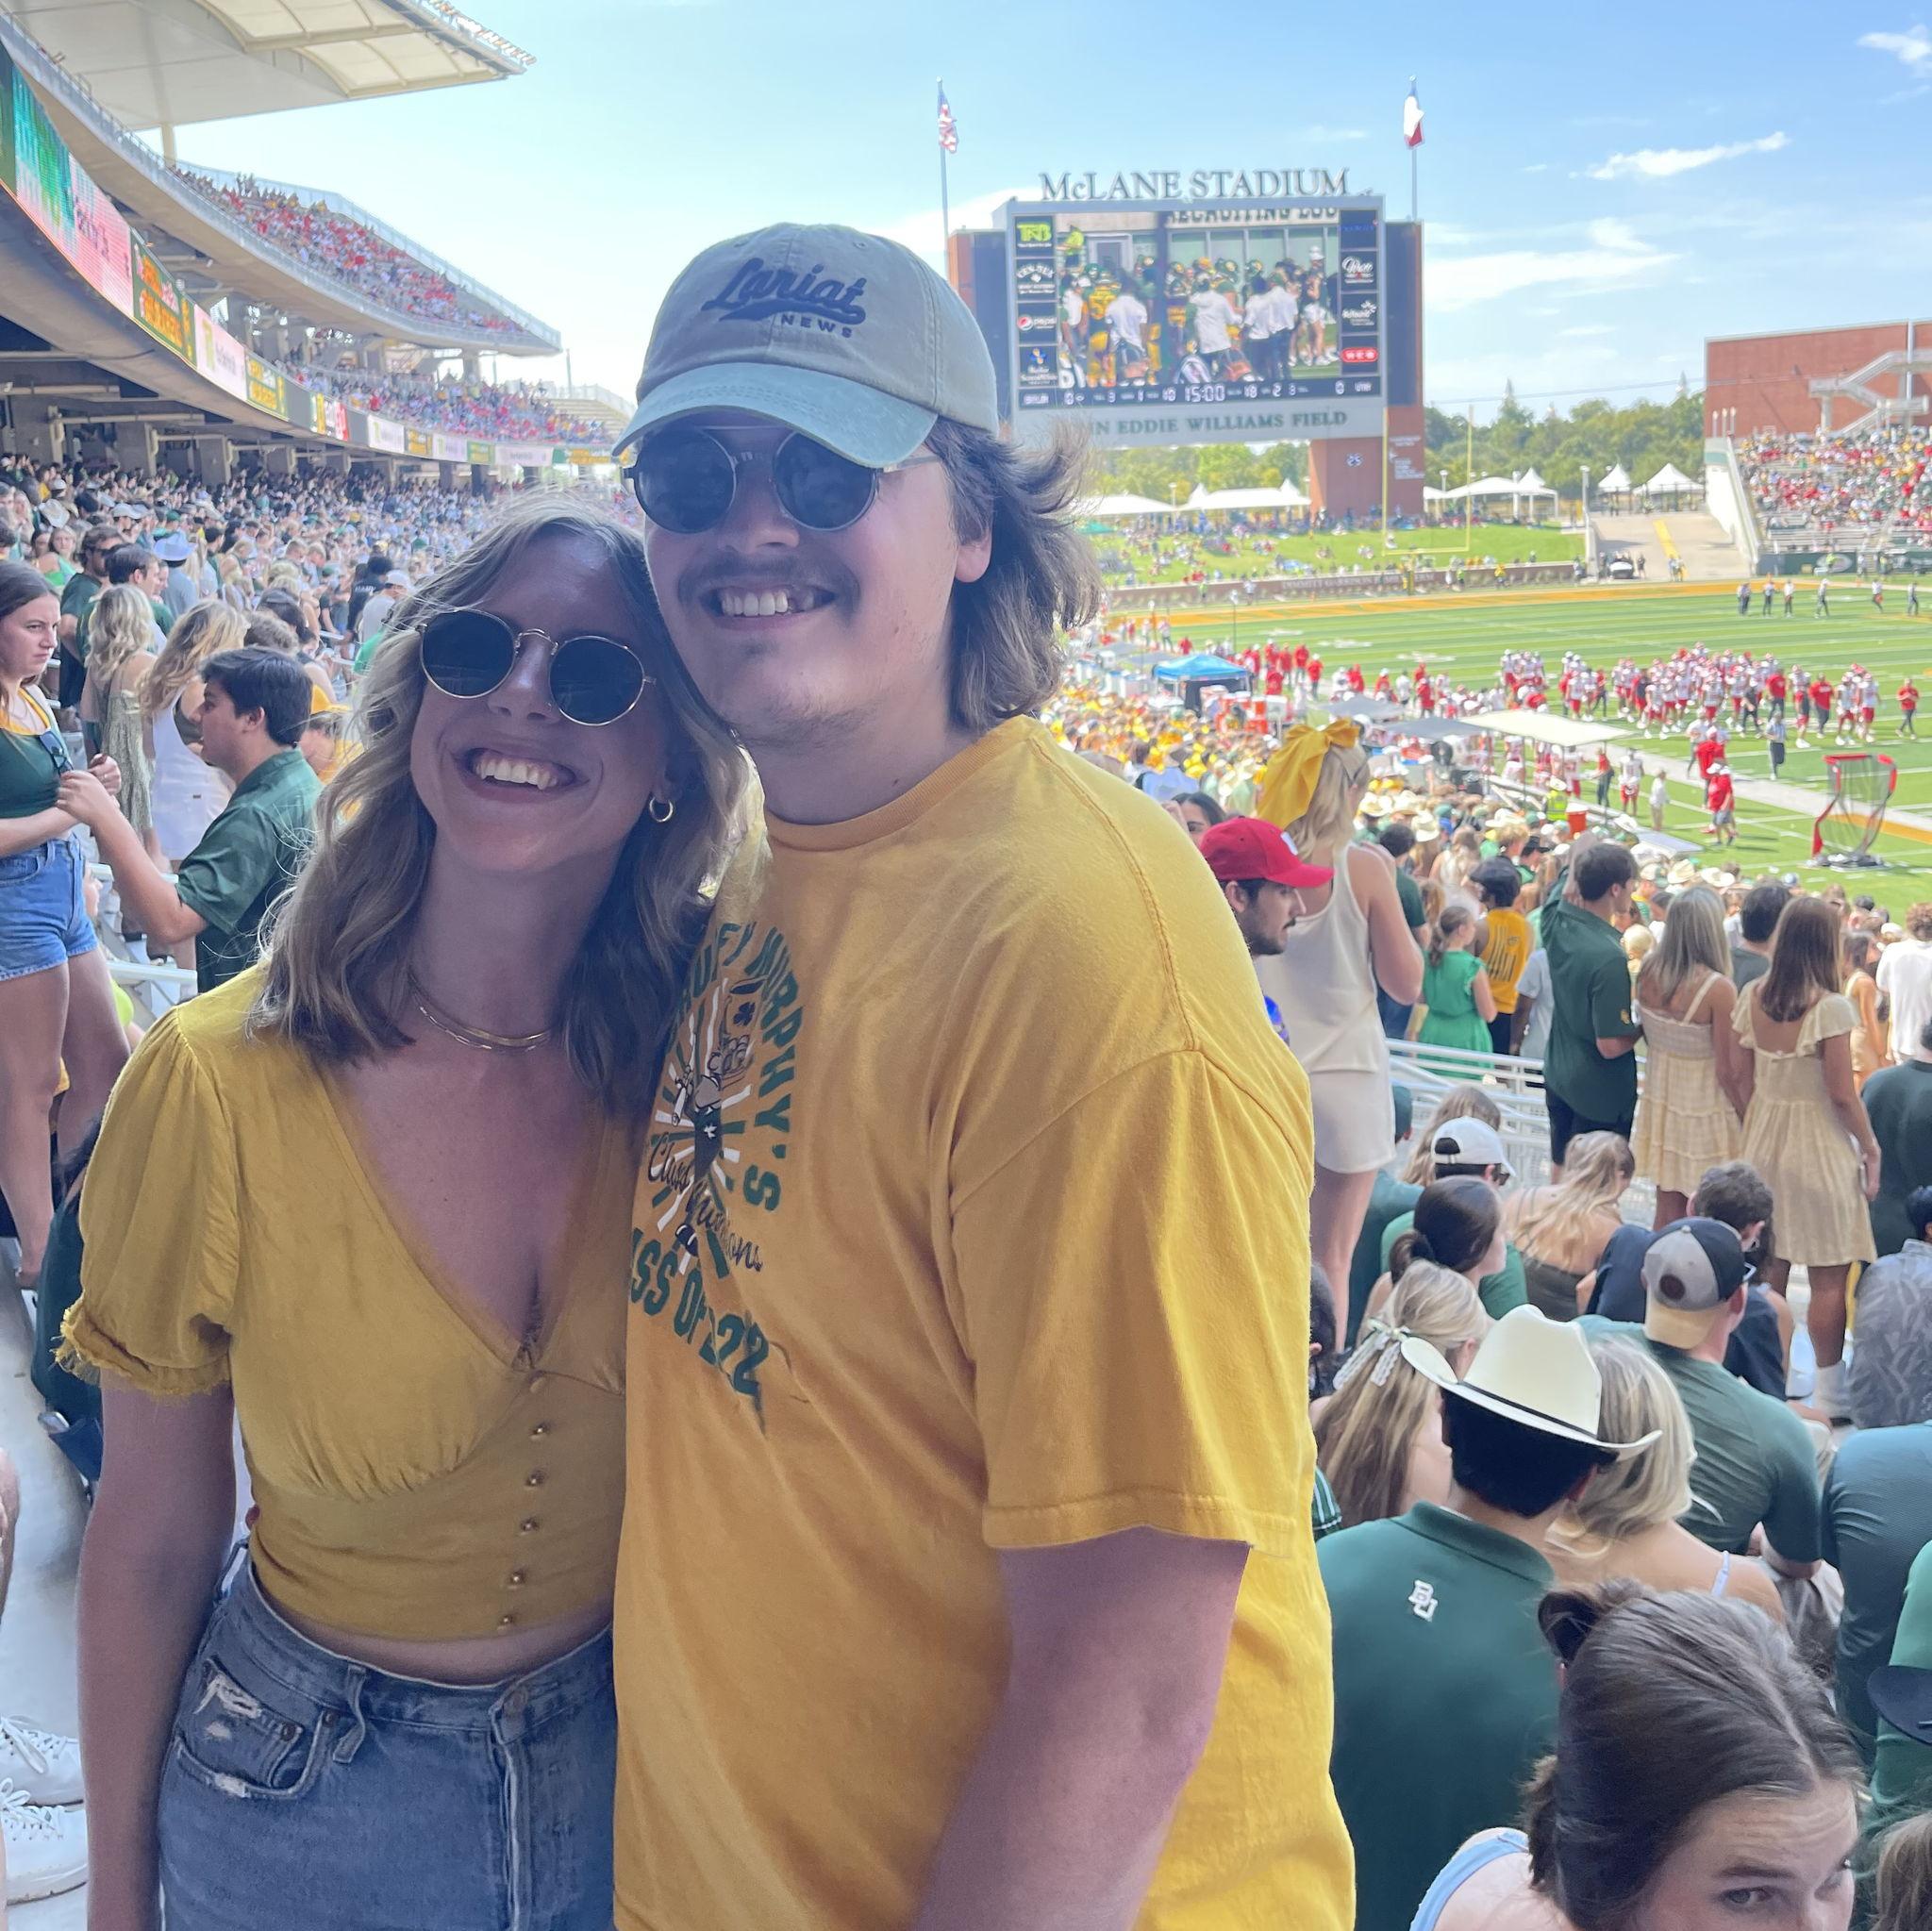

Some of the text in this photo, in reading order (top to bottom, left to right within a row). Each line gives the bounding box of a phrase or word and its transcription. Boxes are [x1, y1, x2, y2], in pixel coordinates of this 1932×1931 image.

[1038, 167, 1349, 201] McLANE STADIUM
[701, 258, 867, 325] Lariat
[780, 314, 852, 338] NEWS
[1184, 384, 1225, 403] 15:00
[1118, 419, 1178, 434] EDDIE
[1187, 413, 1284, 431] WILLIAMS
[1291, 411, 1347, 427] FIELD
